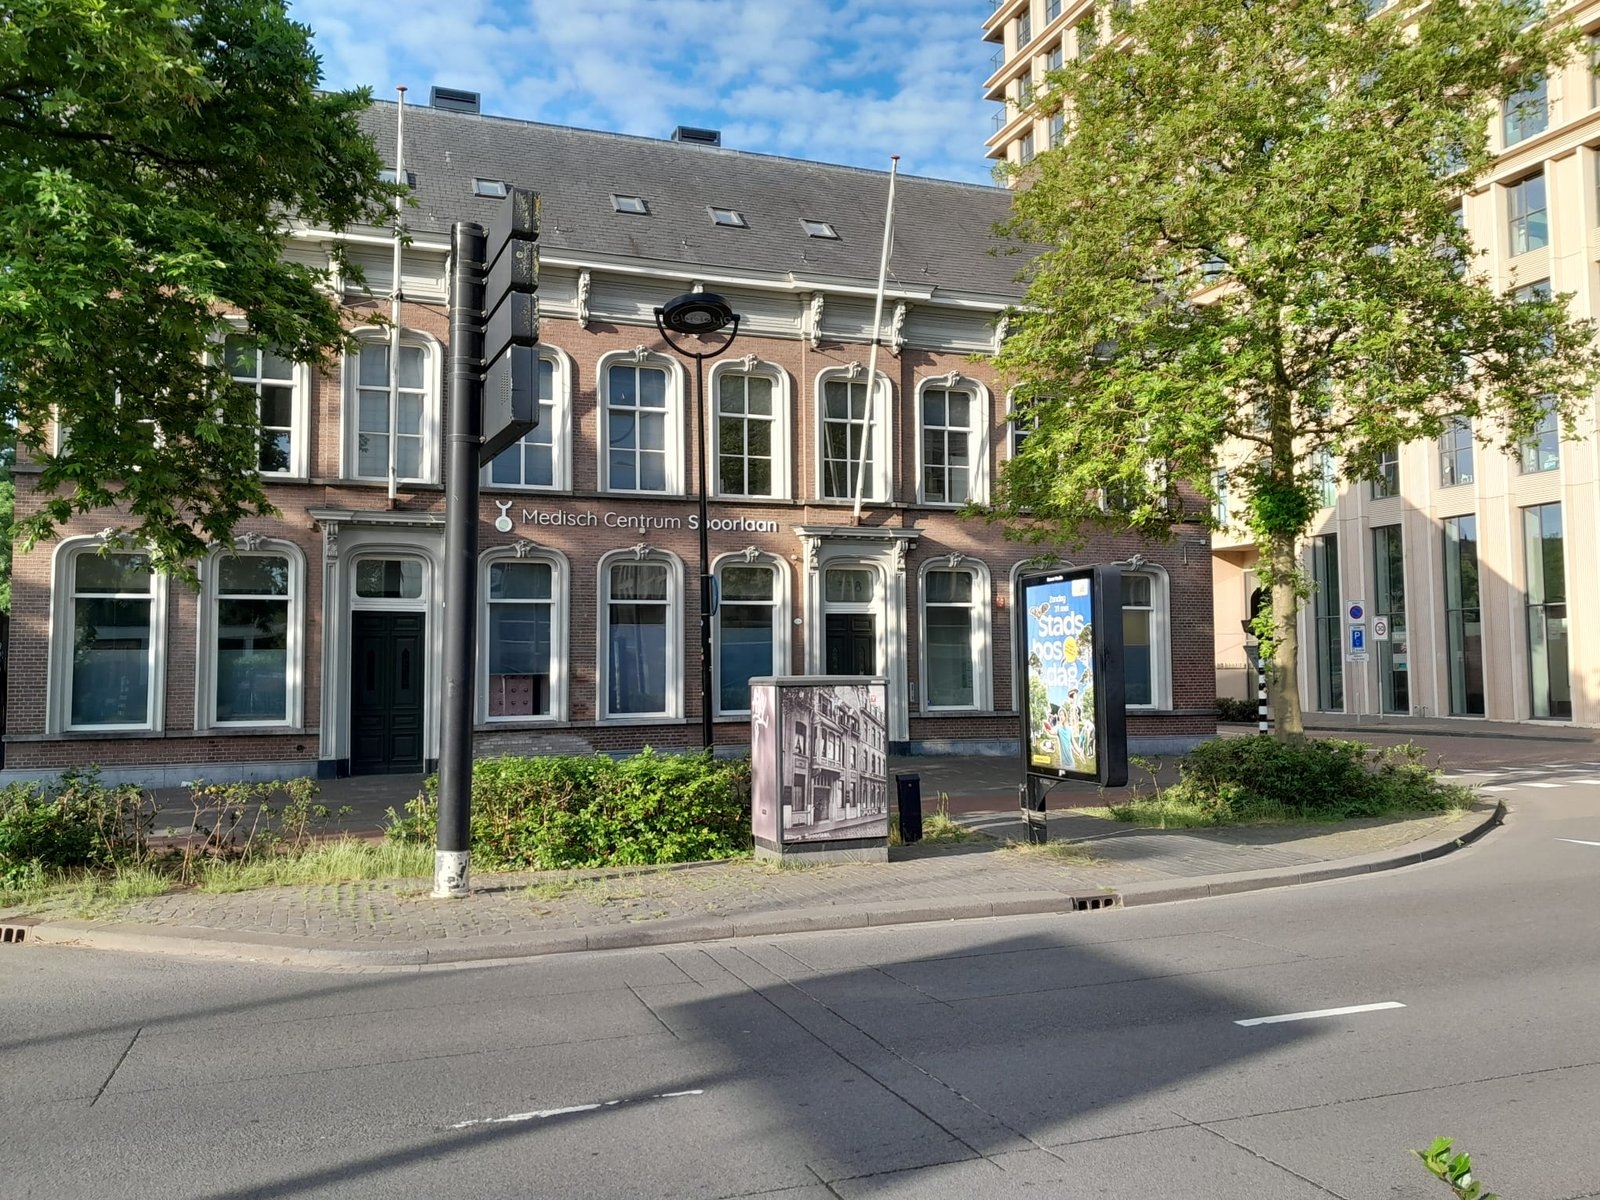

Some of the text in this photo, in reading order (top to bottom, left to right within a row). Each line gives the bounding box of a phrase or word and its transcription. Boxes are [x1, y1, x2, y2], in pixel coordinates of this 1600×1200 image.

[522, 509, 598, 526] Medisch
[604, 511, 681, 529] Centrum
[1354, 632, 1361, 640] P
[1046, 661, 1079, 690] dag
